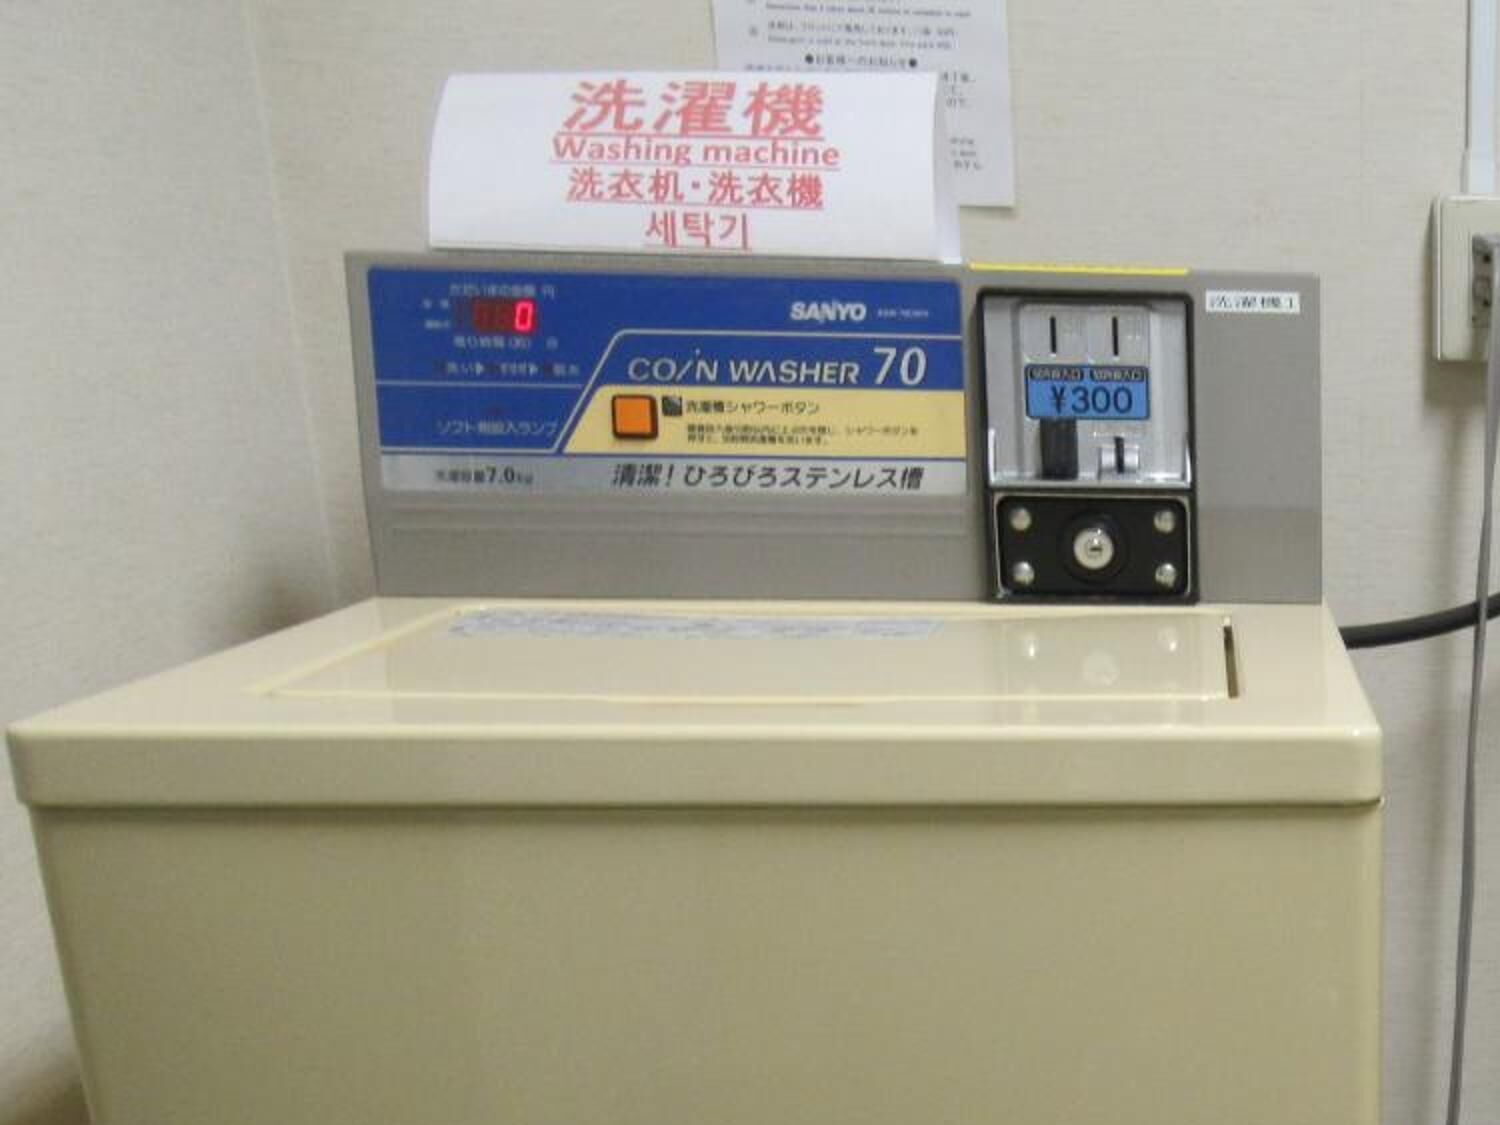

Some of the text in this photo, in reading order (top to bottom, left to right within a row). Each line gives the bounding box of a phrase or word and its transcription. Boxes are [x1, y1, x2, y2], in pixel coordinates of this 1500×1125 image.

[563, 79, 825, 136] 洗濯機
[553, 136, 841, 167] Washing machine
[644, 211, 750, 248] 세탁기
[514, 300, 535, 332] 0
[790, 302, 866, 324] SANYO
[729, 358, 862, 386] WASHER
[873, 346, 929, 387] 70
[1050, 385, 1133, 415] ¥300
